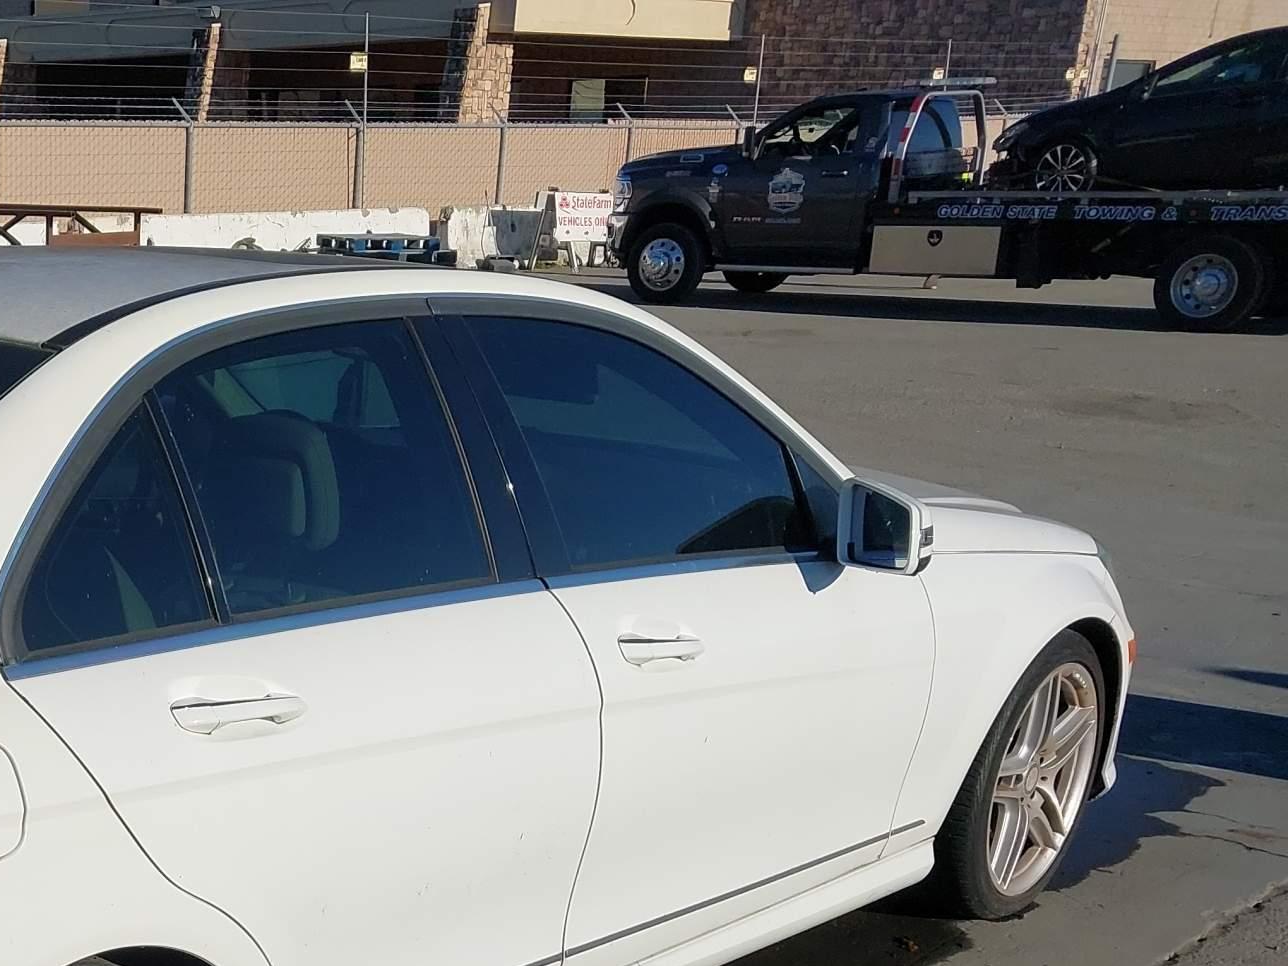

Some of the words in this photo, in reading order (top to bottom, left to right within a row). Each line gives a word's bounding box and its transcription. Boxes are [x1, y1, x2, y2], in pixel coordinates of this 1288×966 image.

[937, 204, 1005, 219] GOLDEN
[1006, 205, 1059, 219] STATE
[1073, 205, 1156, 221] TOWING
[1162, 206, 1177, 221] &
[558, 215, 592, 227] VEHICLES
